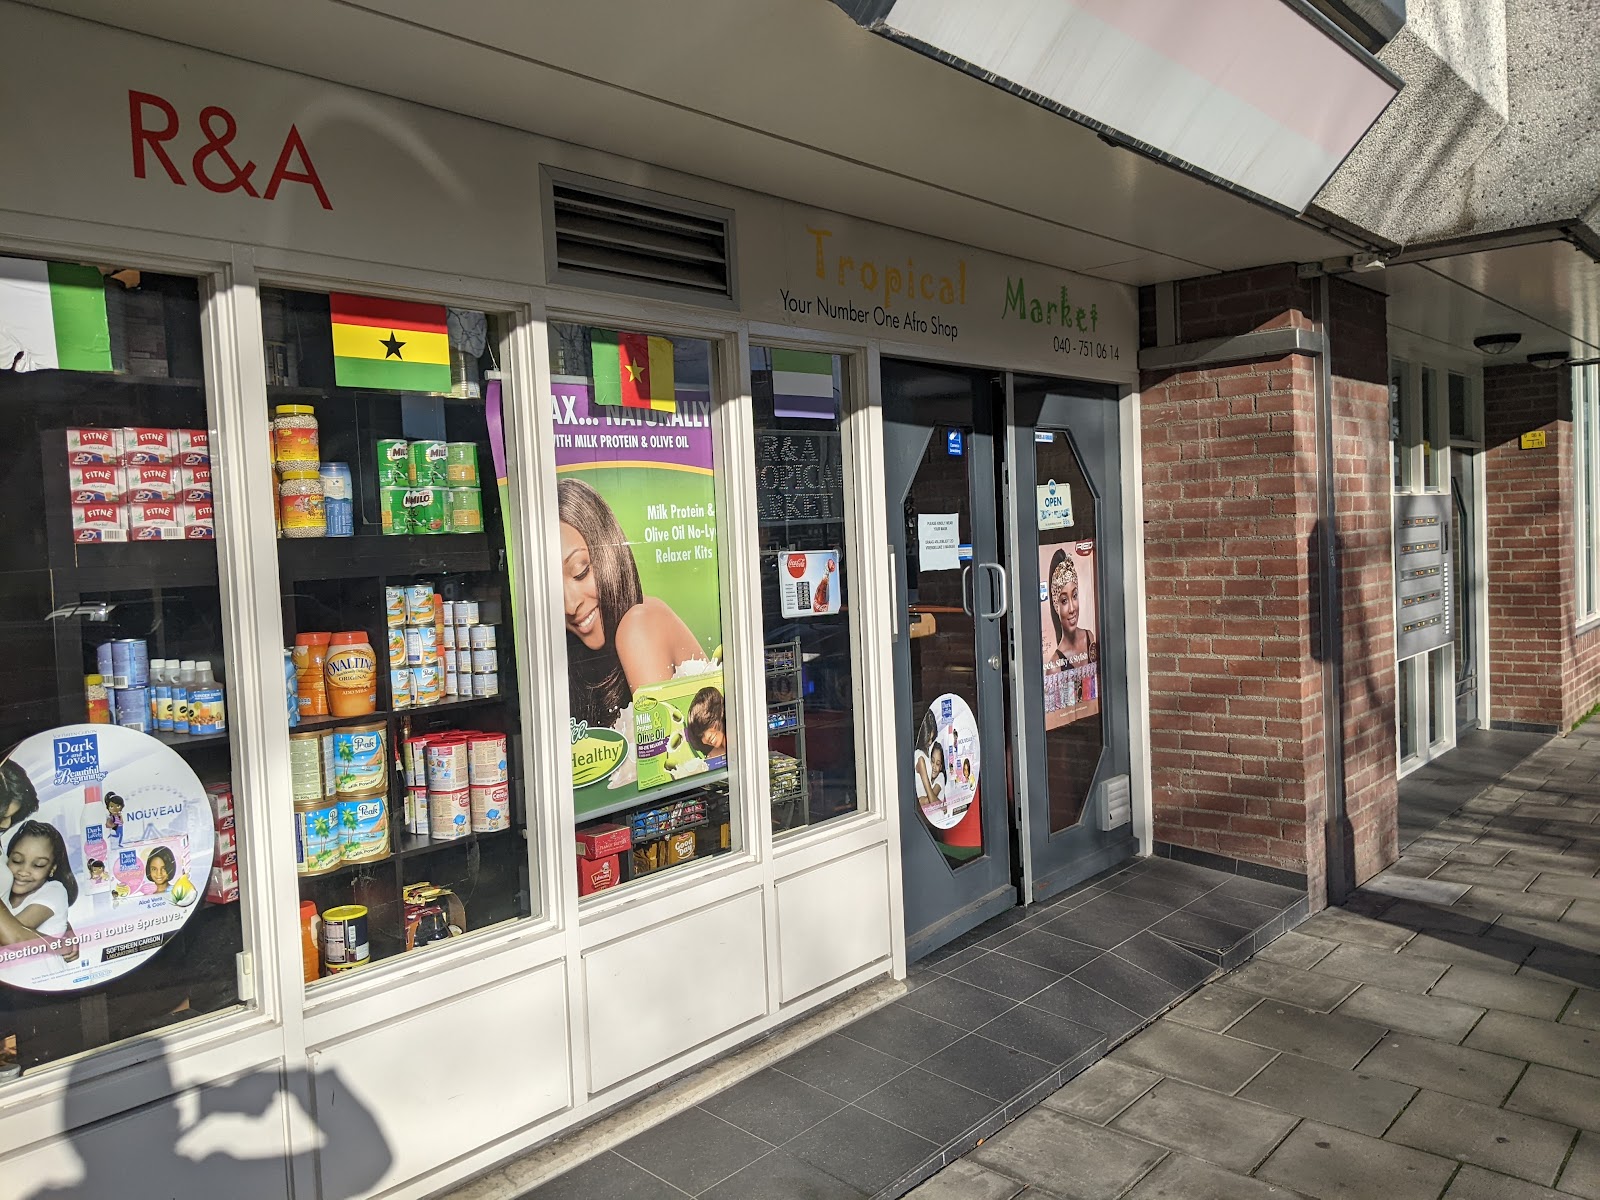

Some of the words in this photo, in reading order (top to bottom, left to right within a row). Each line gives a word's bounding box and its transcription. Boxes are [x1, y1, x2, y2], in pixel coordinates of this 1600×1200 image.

[128, 89, 334, 211] R&A
[806, 223, 966, 310] Tropical
[1001, 276, 1098, 333] Market
[780, 288, 812, 315] Your
[817, 296, 869, 324] Number
[873, 306, 900, 329] One
[903, 311, 928, 334] Afro
[931, 315, 958, 342] Shop
[1053, 335, 1071, 354] 040
[1079, 340, 1093, 358] 751
[1096, 342, 1107, 359] 06
[1110, 344, 1120, 361] 14
[575, 434, 598, 448] MILK
[600, 434, 639, 448] PROTEIN
[641, 435, 648, 448] &
[650, 435, 673, 448] OLIVE
[676, 436, 689, 448] OIL
[392, 447, 408, 457] MIL
[430, 449, 446, 457] MIL
[1045, 497, 1062, 507] OPEN
[647, 504, 668, 520] Milk
[670, 504, 704, 519] Protein
[707, 502, 715, 517] &
[644, 525, 670, 542] Olive
[671, 524, 685, 540] Oil
[687, 523, 717, 541] No-Ly
[655, 547, 692, 563] Relaxer
[694, 545, 713, 559] Kits
[338, 674, 368, 682] ORIGINAL
[636, 713, 652, 726] Milk
[637, 732, 655, 744] Olive
[655, 727, 665, 740] Oil
[57, 738, 94, 754] Dark
[354, 738, 375, 750] Peak
[127, 803, 183, 822] NOUVEAU
[358, 805, 378, 816] Peak
[675, 837, 693, 850] Good
[678, 844, 693, 857] Day
[50, 938, 63, 950] et
[65, 933, 92, 947] soin
[94, 929, 102, 940] à
[104, 922, 135, 938] toute
[138, 935, 161, 946] CARSON
